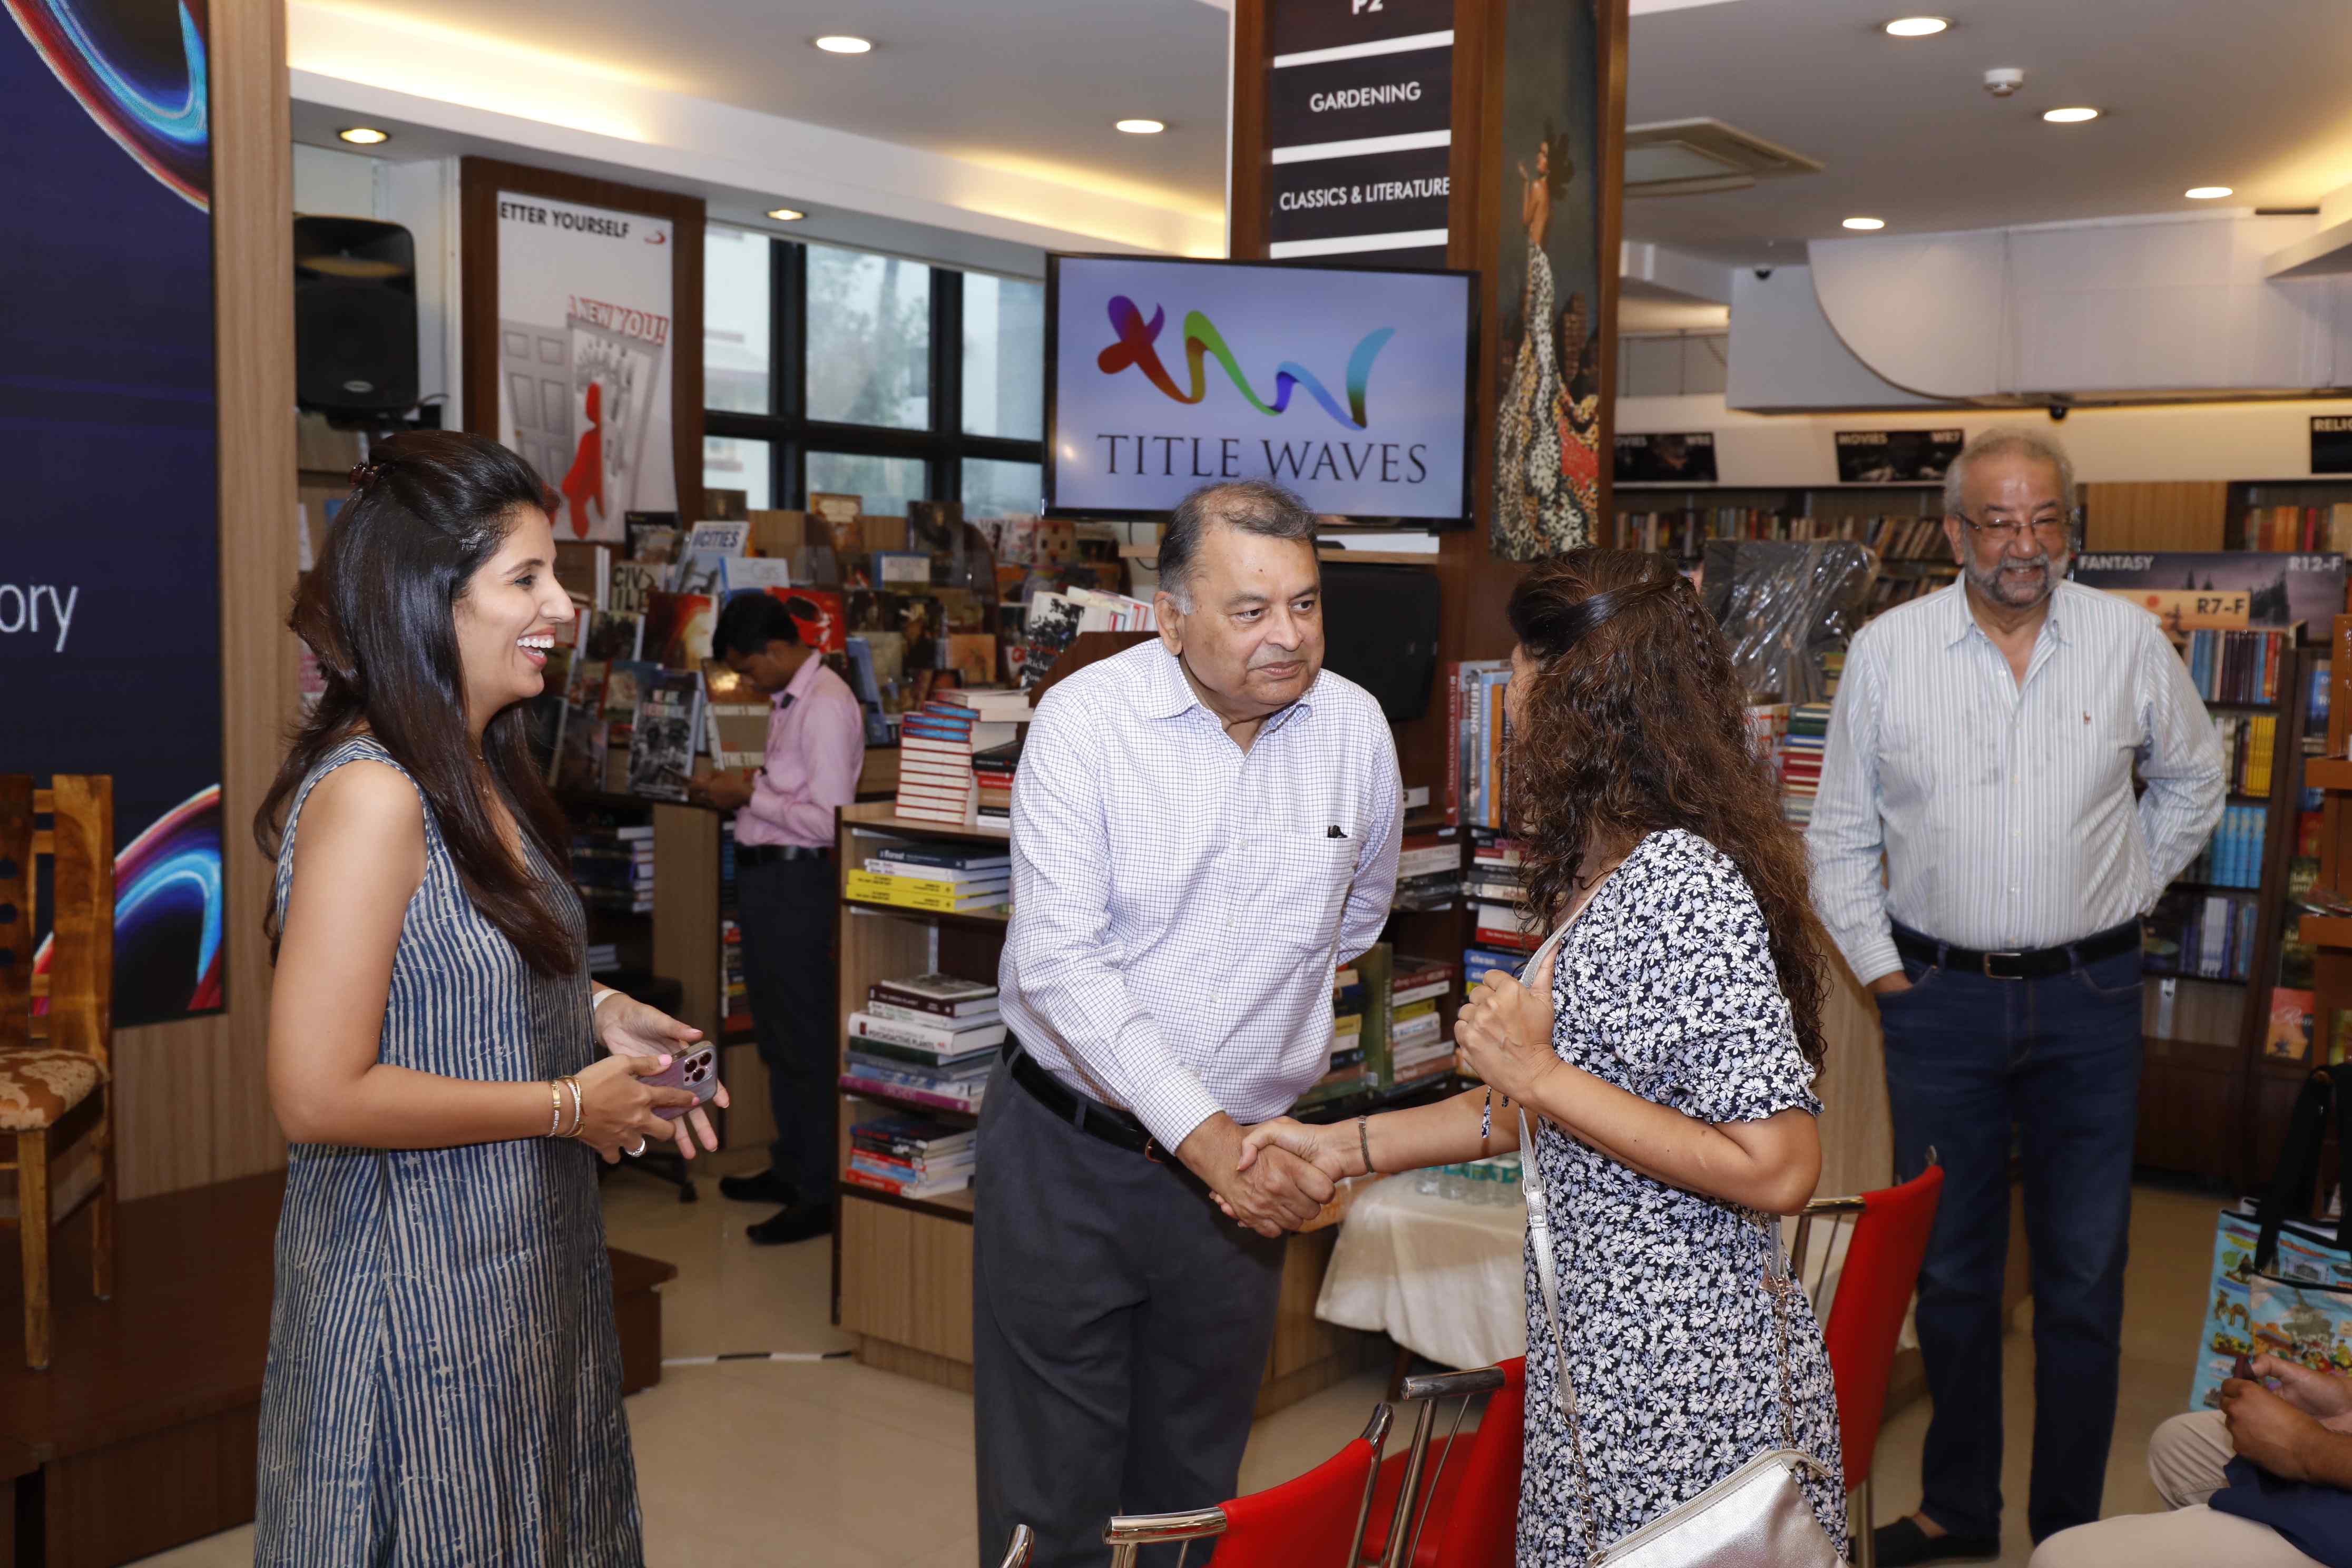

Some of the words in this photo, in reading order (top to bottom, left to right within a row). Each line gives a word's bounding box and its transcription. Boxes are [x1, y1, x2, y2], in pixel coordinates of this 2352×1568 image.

[1310, 81, 1422, 112] GARDENING
[1279, 185, 1347, 211] CLASSICS
[1351, 186, 1362, 204] &
[1366, 177, 1451, 203] LITERATURE
[500, 202, 547, 225] ETTER
[552, 210, 630, 238] YOURSELF
[1838, 433, 1888, 445] MOVIES
[1096, 434, 1240, 477] TITLE
[1260, 439, 1428, 484] WAVES
[2077, 555, 2155, 571] FANTASY
[2287, 556, 2341, 572] R12-F
[0, 584, 79, 653] ory
[2197, 597, 2246, 615] R7-F
[1470, 682, 1479, 734] BEIJING
[1470, 954, 1496, 966] clean
